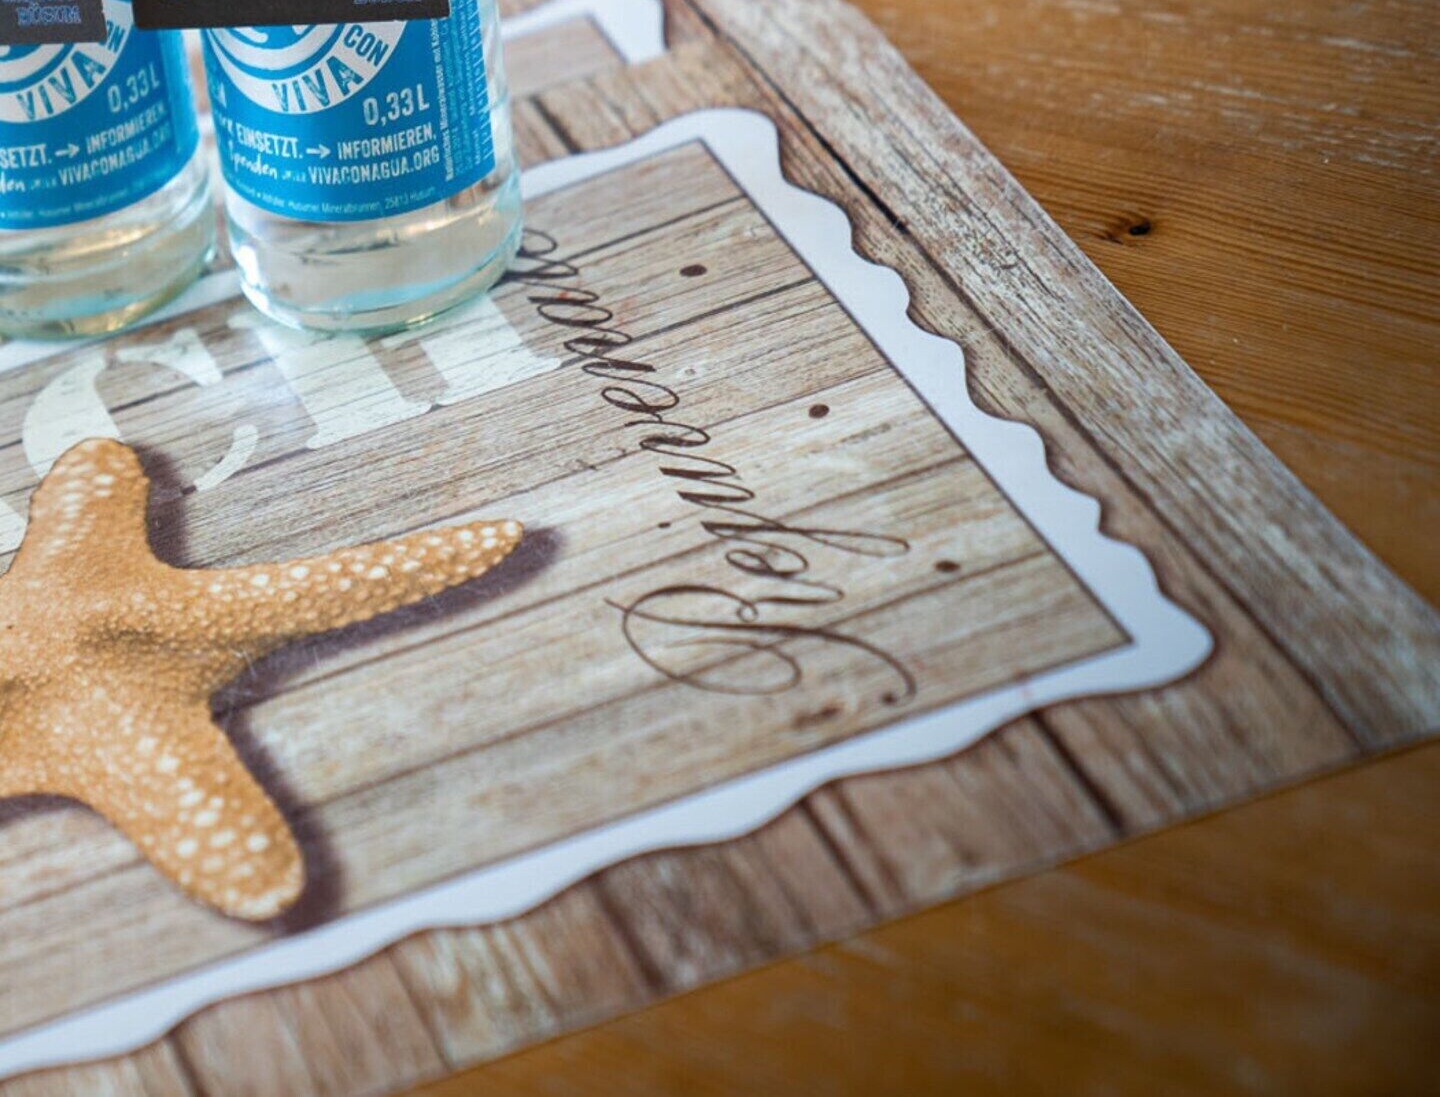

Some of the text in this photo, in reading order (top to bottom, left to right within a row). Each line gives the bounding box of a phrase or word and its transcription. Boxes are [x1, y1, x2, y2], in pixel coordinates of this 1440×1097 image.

[16, 50, 107, 121] VIVA
[272, 23, 389, 112] VIVA CON
[236, 122, 303, 159] EINSETZT.
[336, 122, 438, 161] INFORMIEREN.
[308, 145, 440, 185] VIVACONAGUA.ORG
